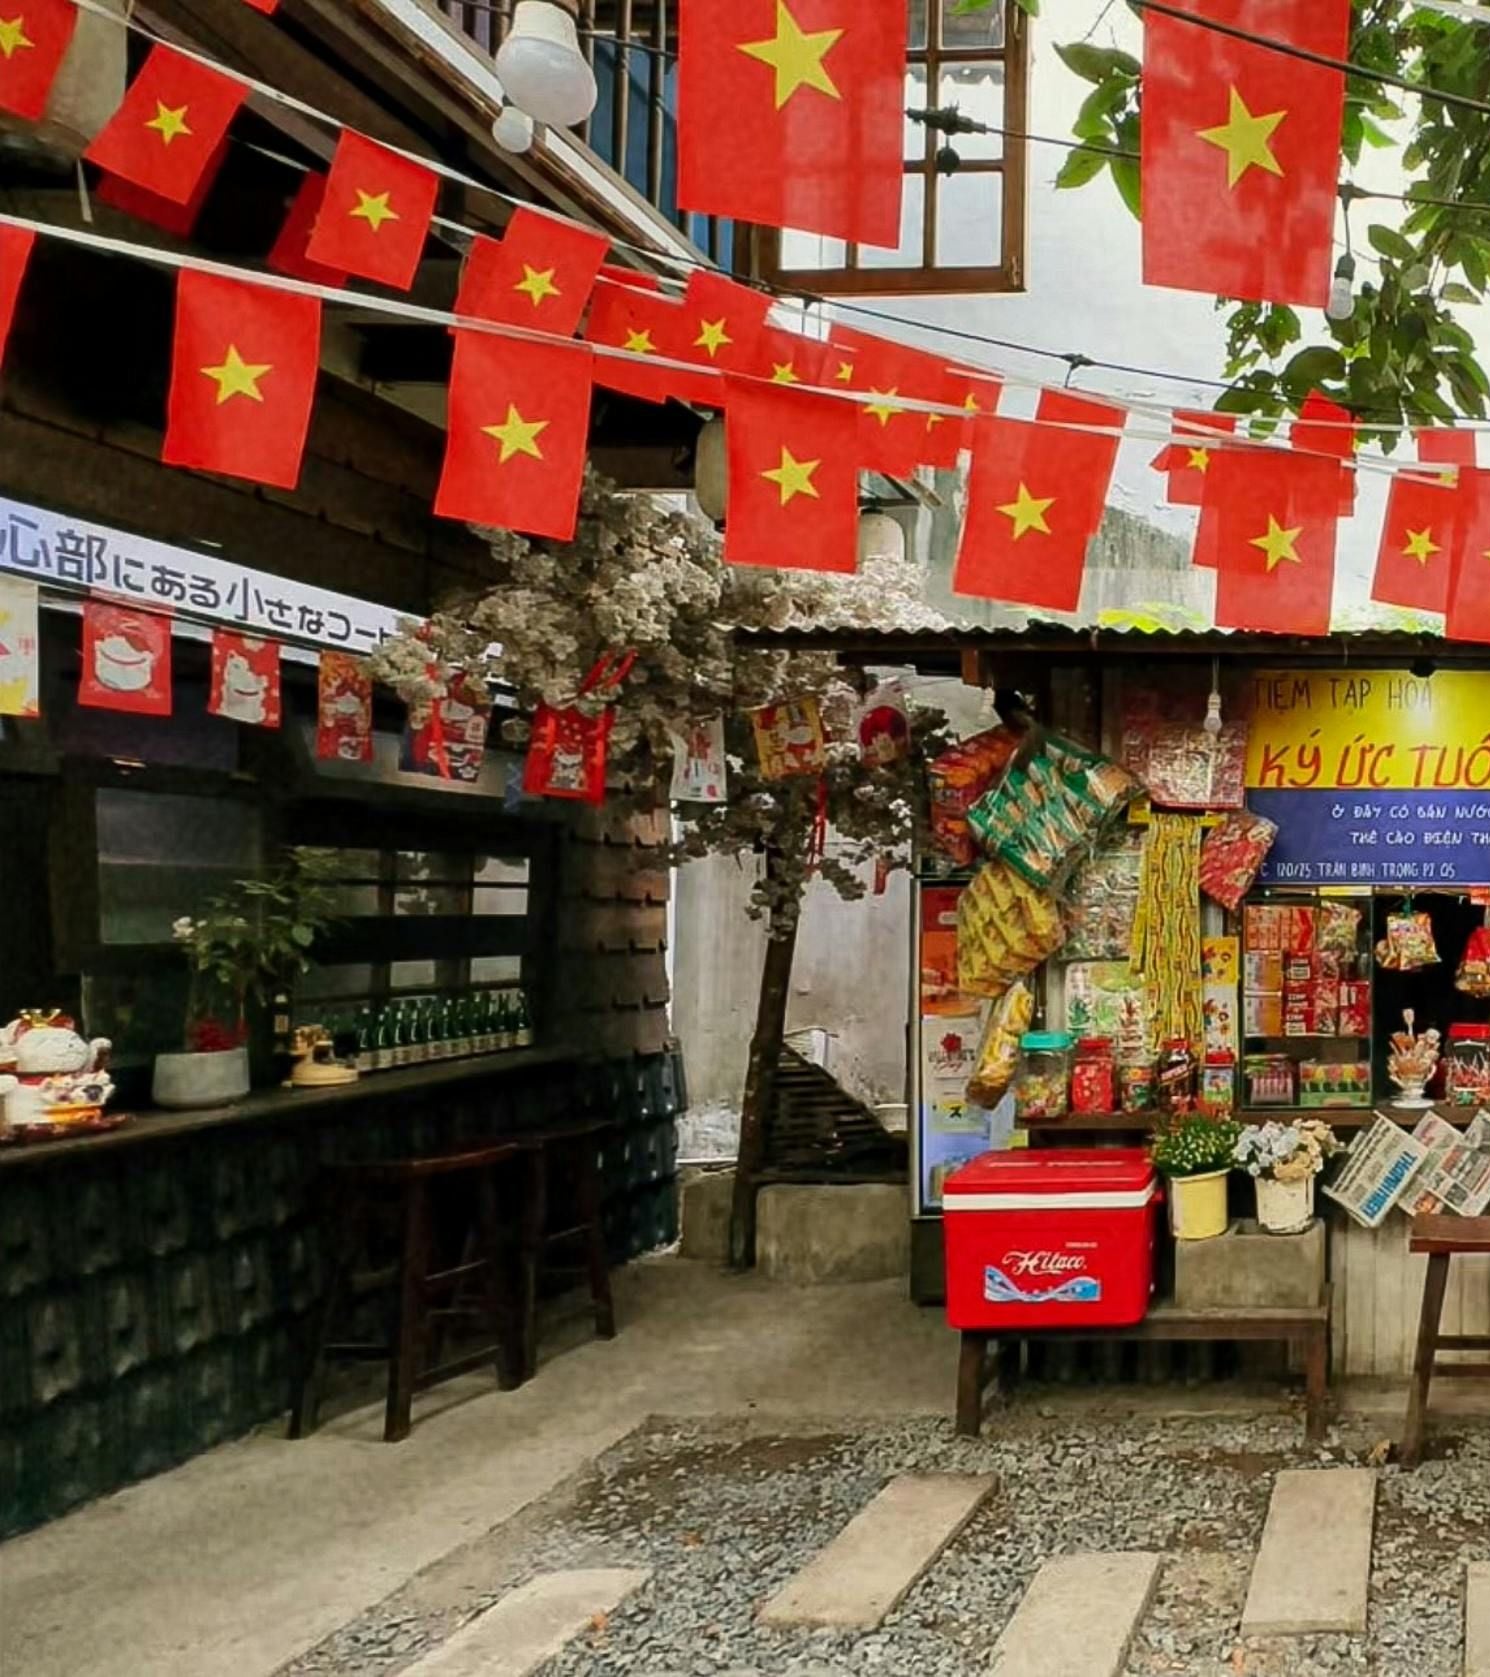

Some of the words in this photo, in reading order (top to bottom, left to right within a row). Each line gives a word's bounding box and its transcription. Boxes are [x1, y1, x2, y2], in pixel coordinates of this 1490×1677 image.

[1329, 678, 1371, 714] TẠP
[1258, 728, 1322, 787] KÝ
[1335, 734, 1395, 787] ỨC
[1389, 803, 1410, 819] CÓ
